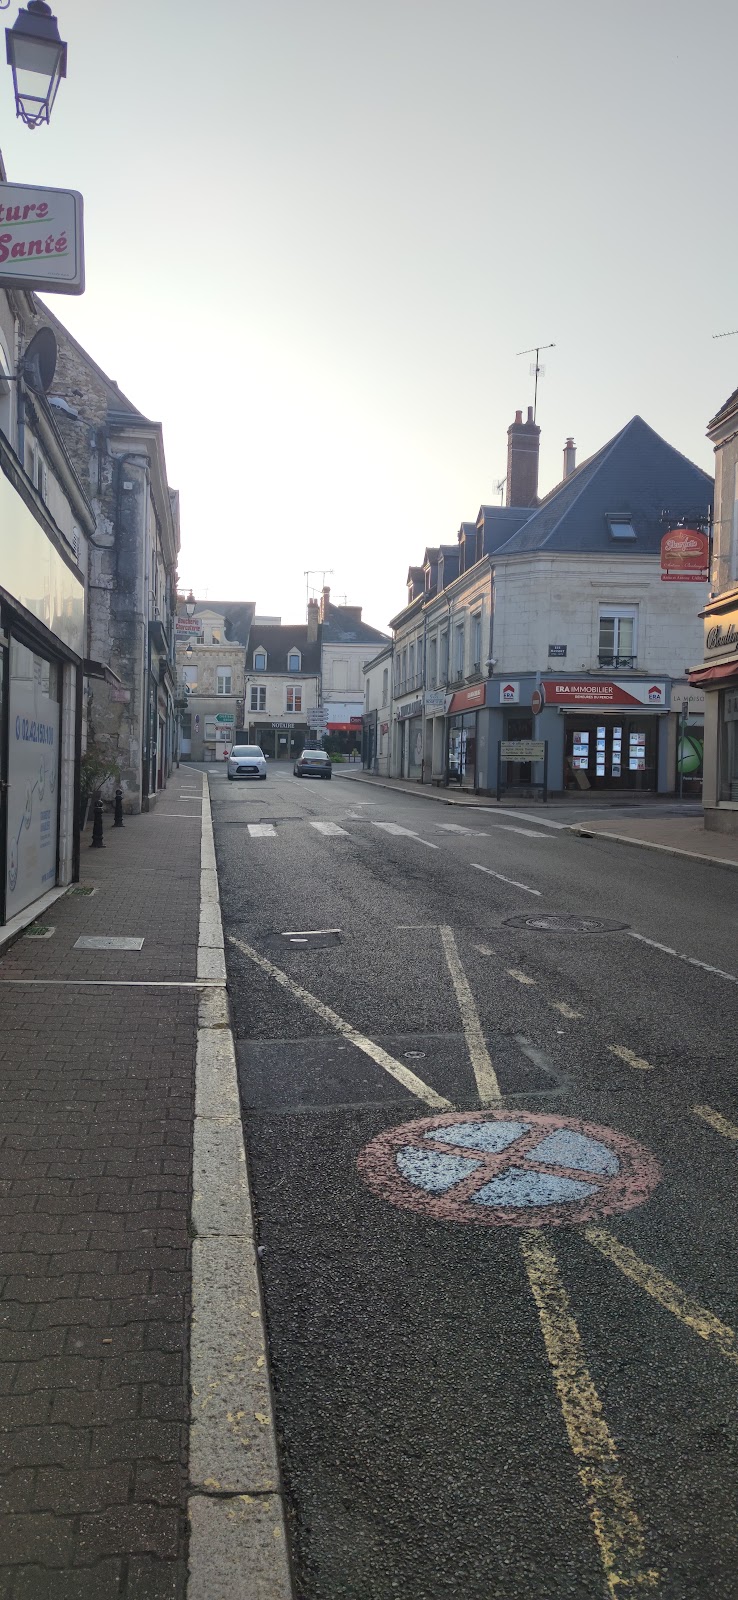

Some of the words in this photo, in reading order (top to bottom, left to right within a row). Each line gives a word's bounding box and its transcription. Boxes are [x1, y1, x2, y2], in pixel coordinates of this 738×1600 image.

[0, 231, 67, 263] Santé
[556, 685, 570, 693] ERA
[570, 685, 613, 693] IMMOBILIER
